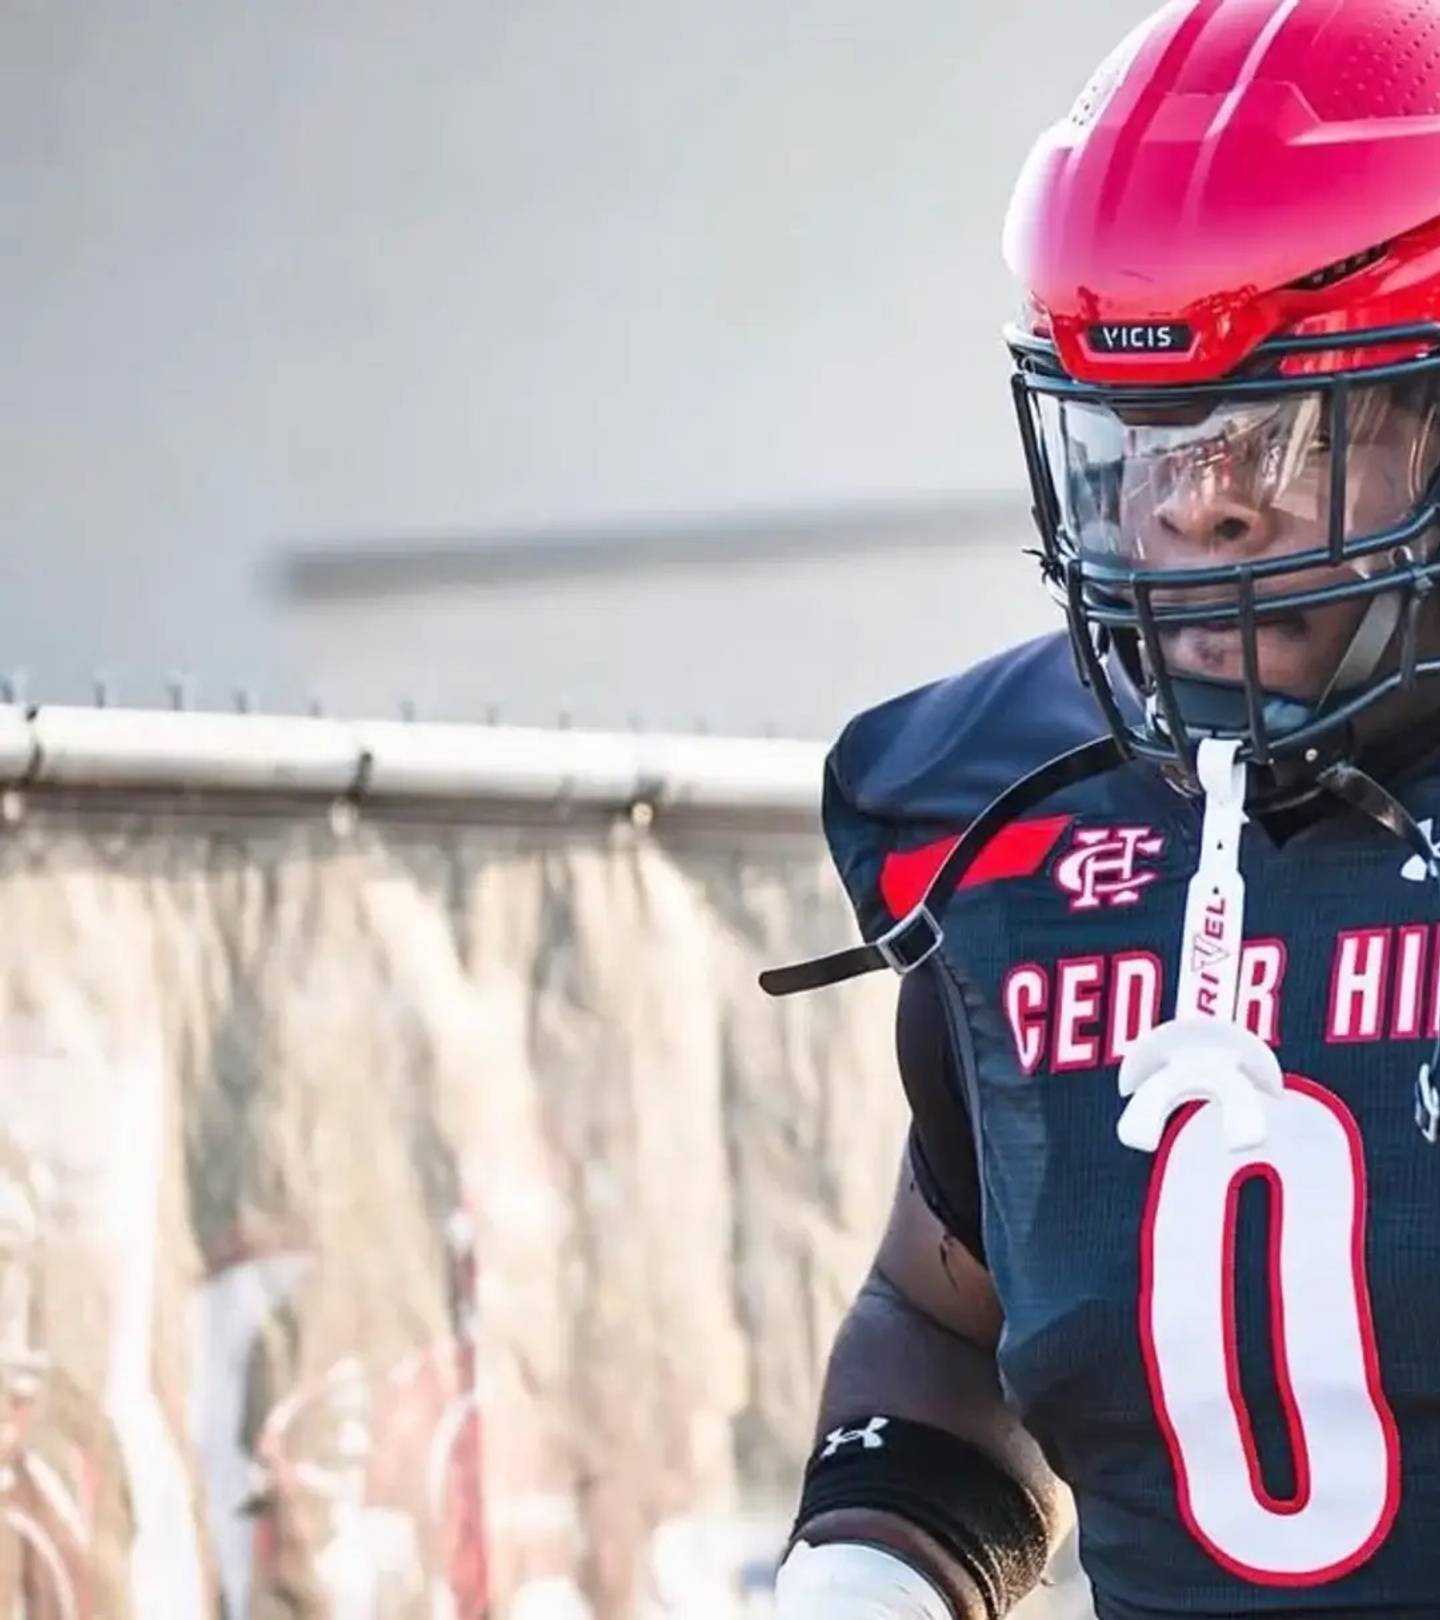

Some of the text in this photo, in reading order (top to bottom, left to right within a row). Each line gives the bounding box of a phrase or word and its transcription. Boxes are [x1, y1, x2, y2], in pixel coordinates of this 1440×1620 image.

[1102, 326, 1172, 349] VICIS
[1002, 937, 1287, 1074] CEDR
[1191, 898, 1230, 1017] RIVEL
[1137, 1073, 1401, 1587] 0
